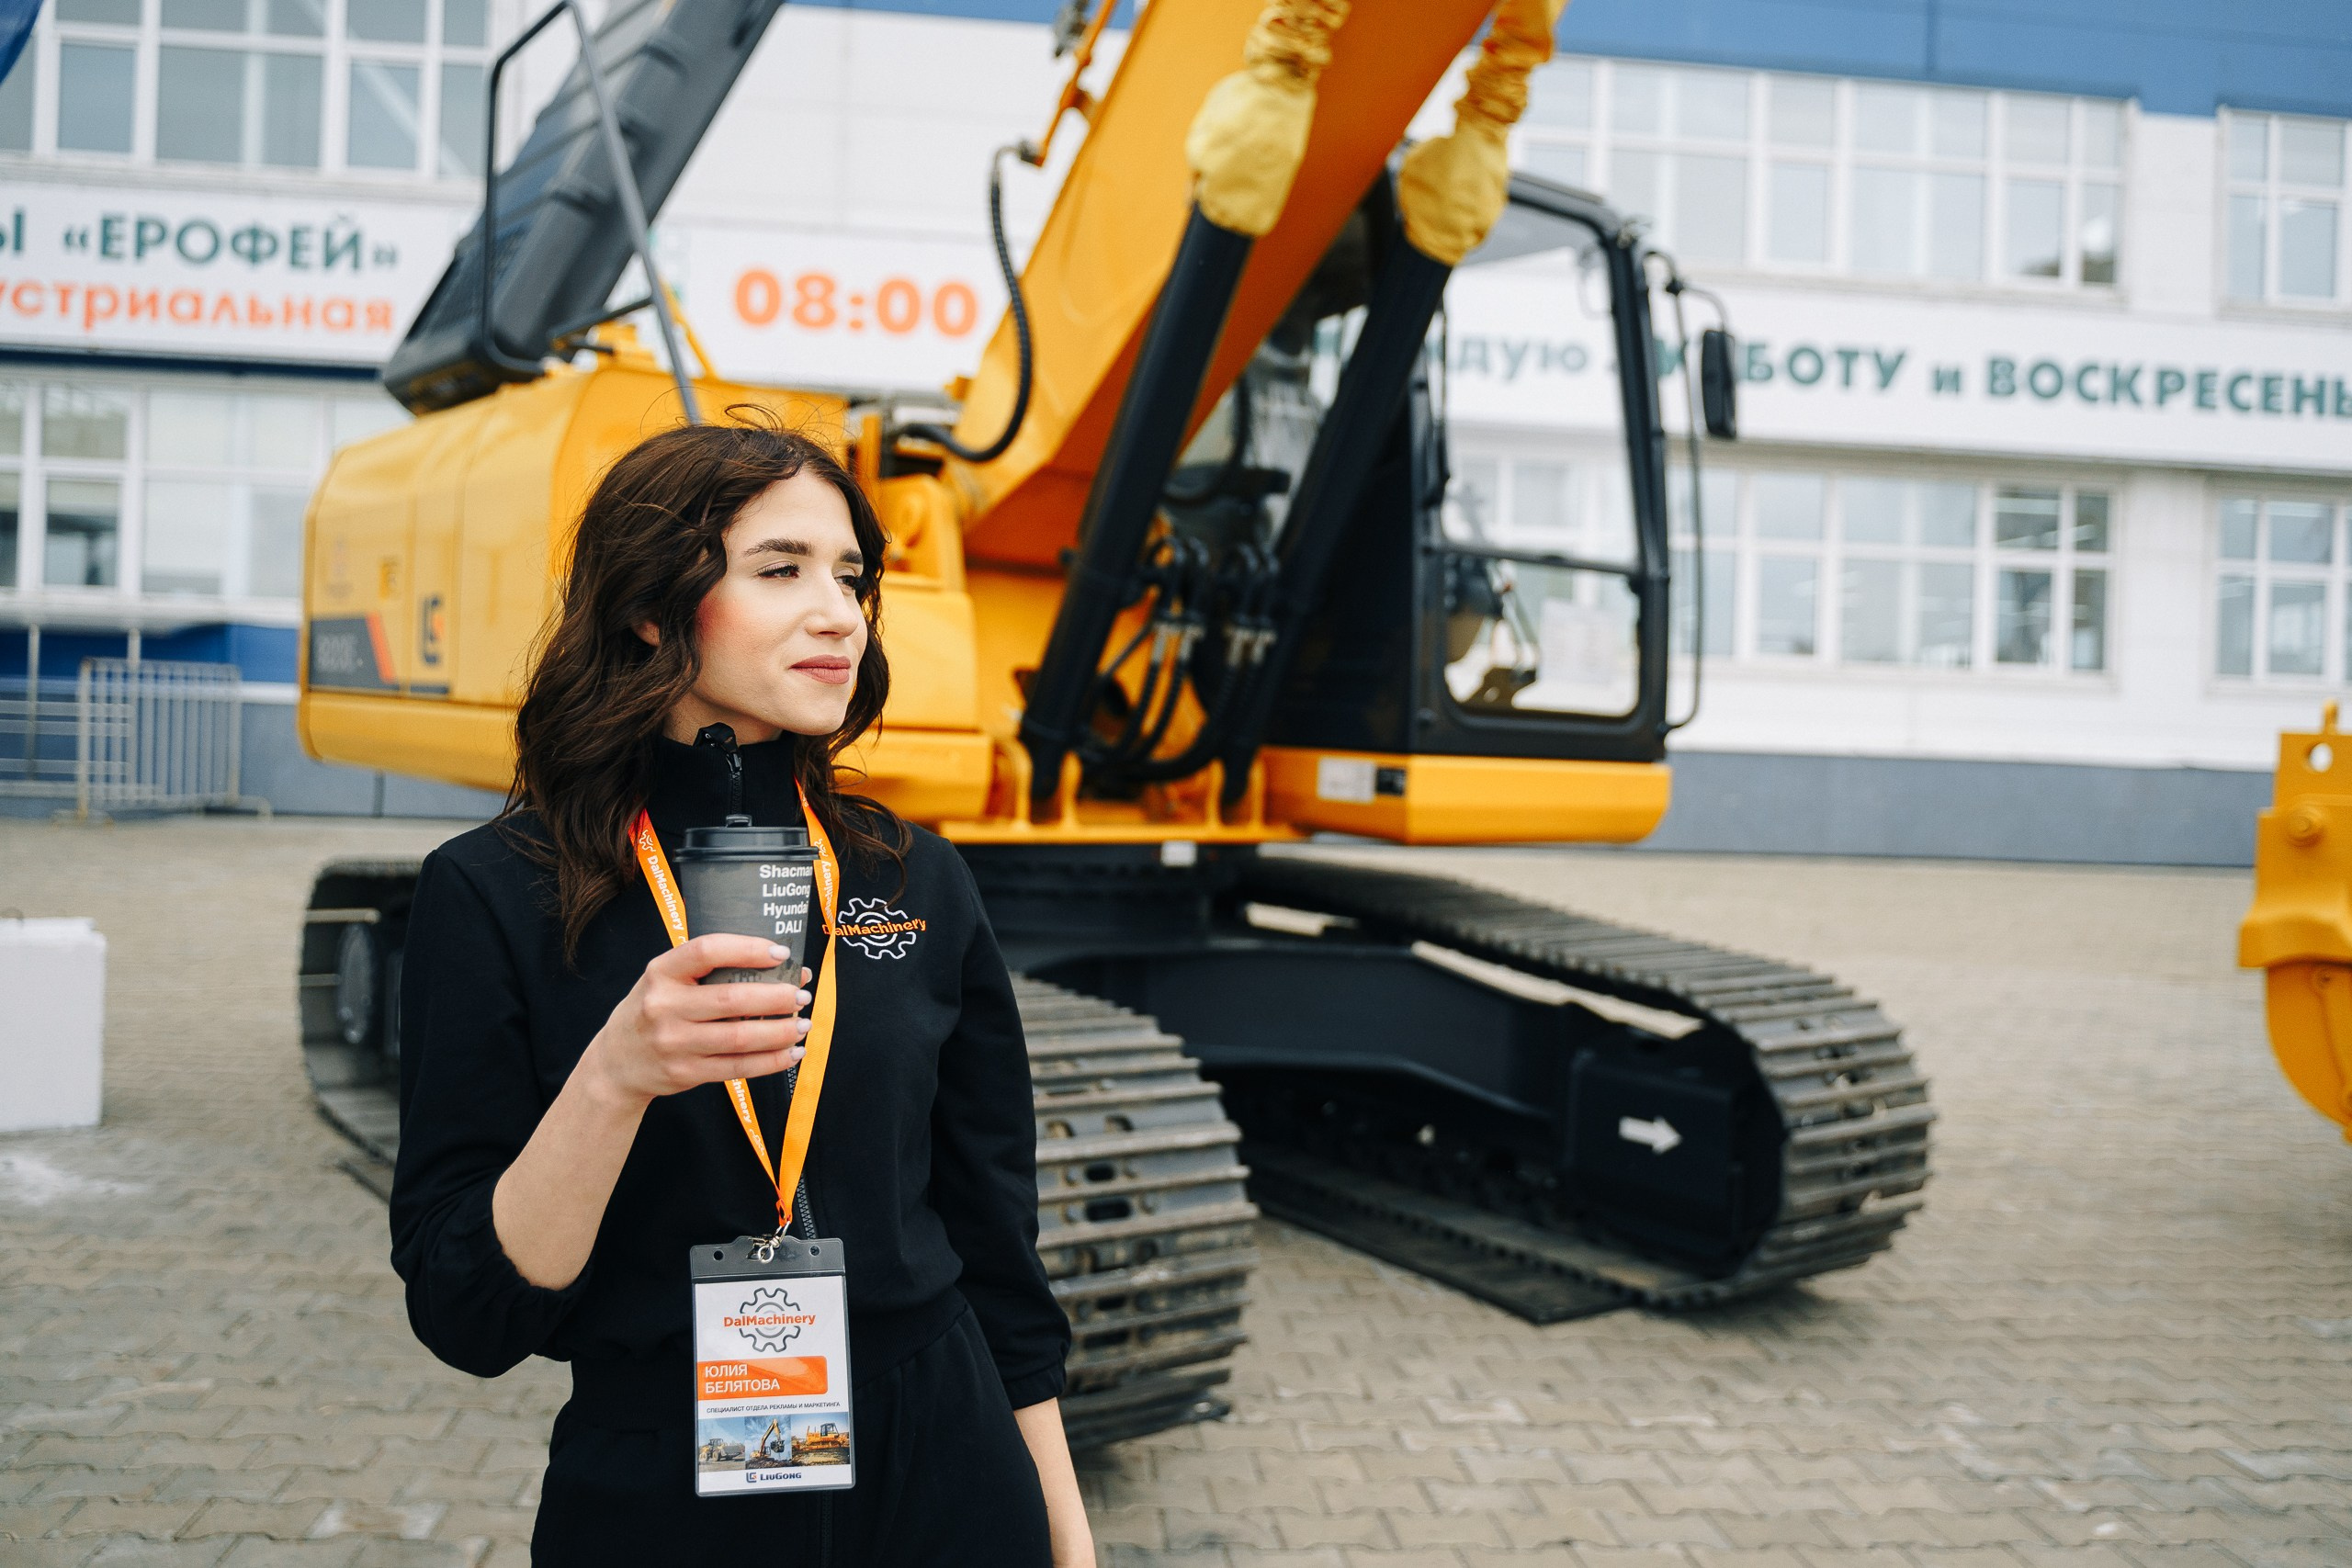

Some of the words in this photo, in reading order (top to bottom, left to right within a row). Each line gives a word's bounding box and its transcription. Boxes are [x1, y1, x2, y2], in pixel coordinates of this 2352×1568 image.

[735, 270, 978, 337] 08:00
[763, 883, 810, 898] LiuGong
[763, 901, 808, 919] Hyundai
[723, 1314, 816, 1327] DalMachinery
[705, 1363, 748, 1378] ЮЛИЯ
[706, 1378, 780, 1393] БЕЛЯТОВА
[707, 1405, 745, 1414] СПЕЦИАЛИСТ
